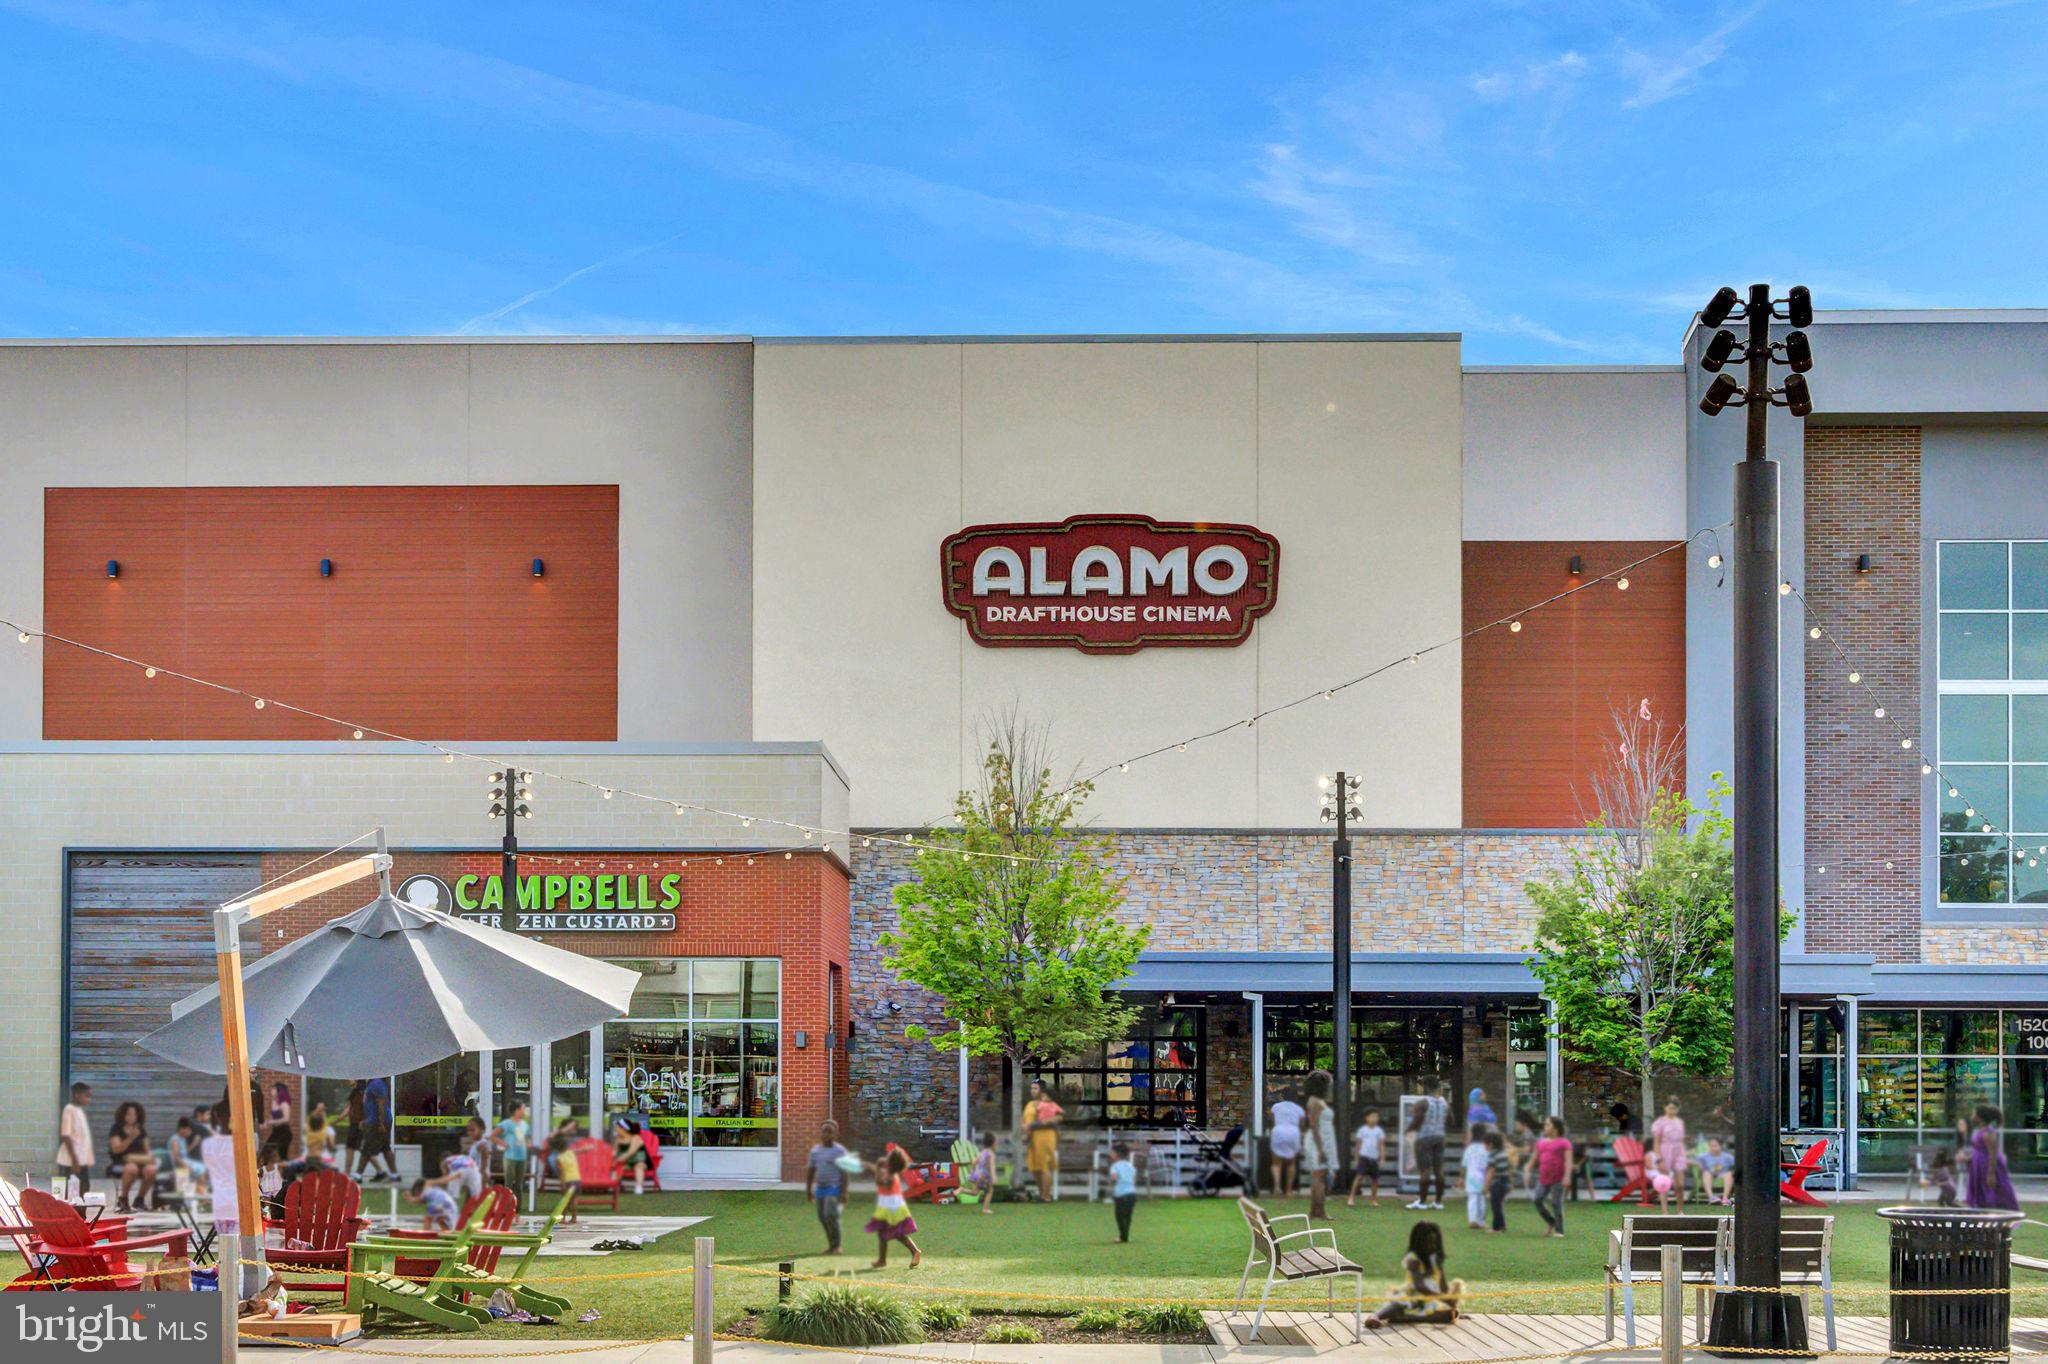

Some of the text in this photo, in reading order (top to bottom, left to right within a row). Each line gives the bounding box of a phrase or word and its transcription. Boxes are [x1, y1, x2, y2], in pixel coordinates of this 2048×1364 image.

[973, 545, 1248, 597] ALAMO
[987, 606, 1232, 622] DRAFTHOUSE CINEMA
[455, 873, 682, 910] CAMPBELLS
[479, 915, 656, 929] FRZEN CUSTARD
[630, 1067, 683, 1090] OPEN
